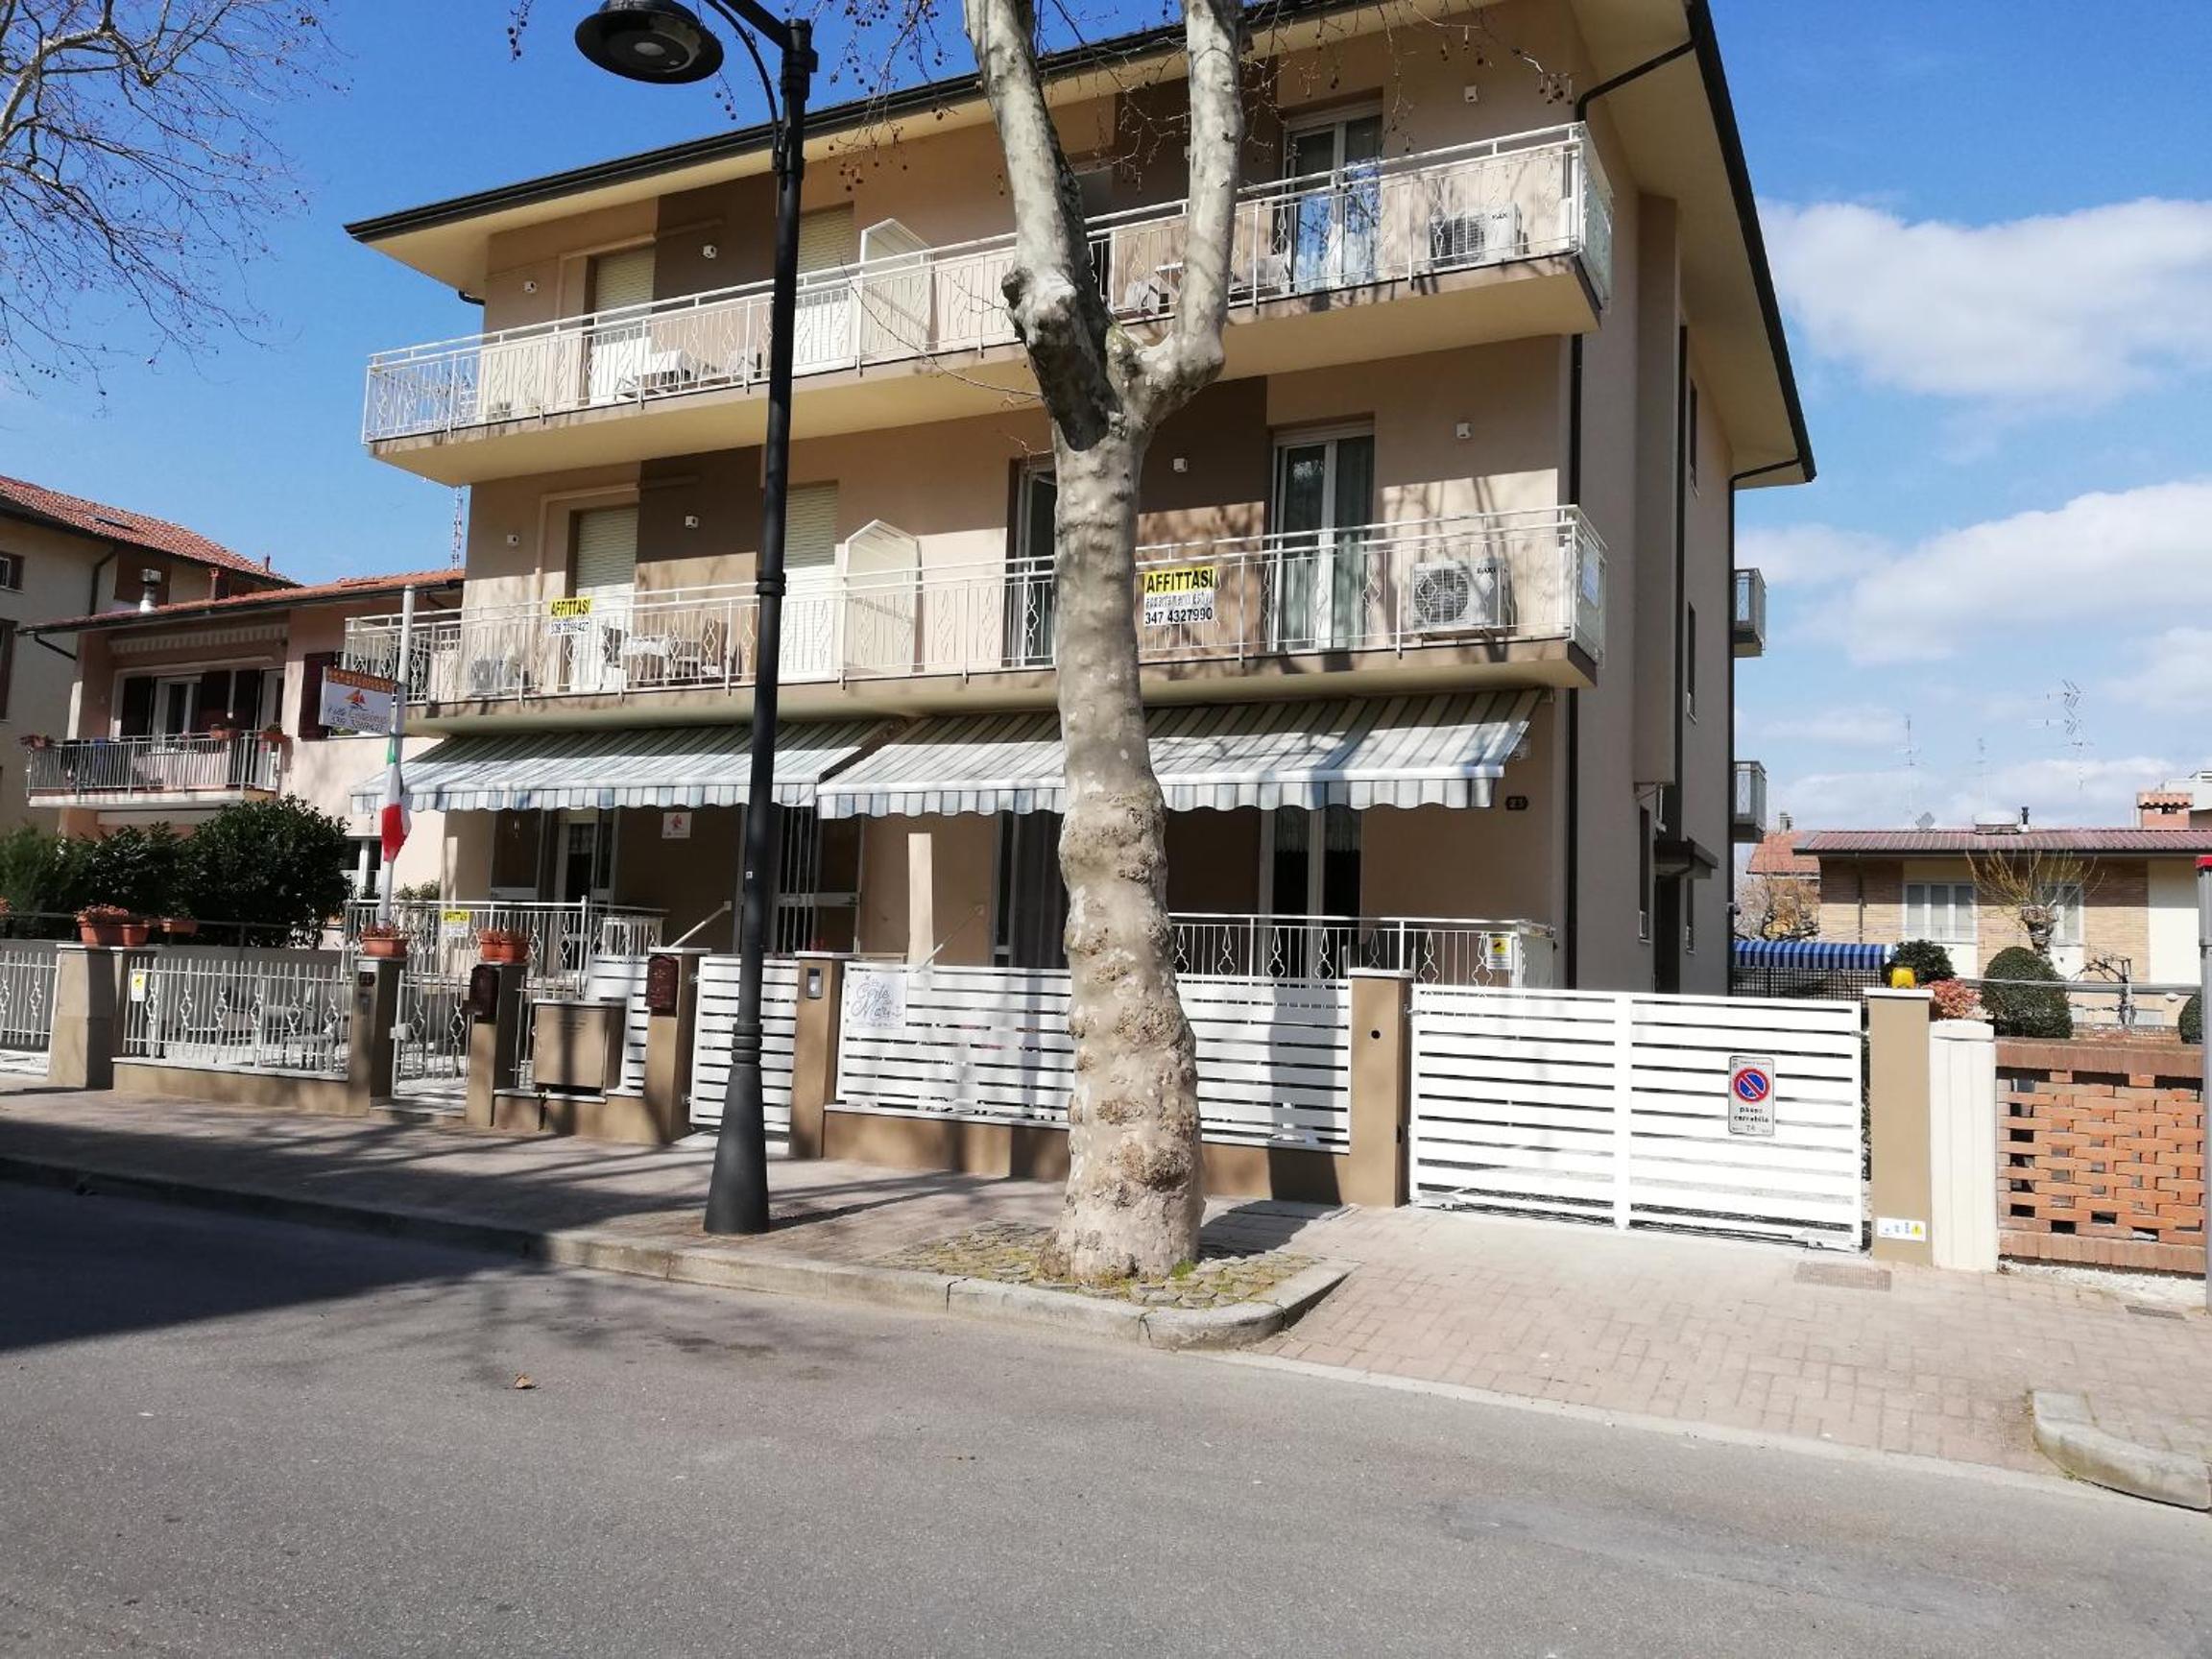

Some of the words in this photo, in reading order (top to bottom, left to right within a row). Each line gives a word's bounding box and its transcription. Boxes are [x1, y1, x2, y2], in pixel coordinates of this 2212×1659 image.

[1145, 568, 1214, 593] AFFITTASI
[551, 599, 590, 616] AFFITTASI
[1144, 612, 1165, 625] 347
[1167, 607, 1214, 623] 4327990
